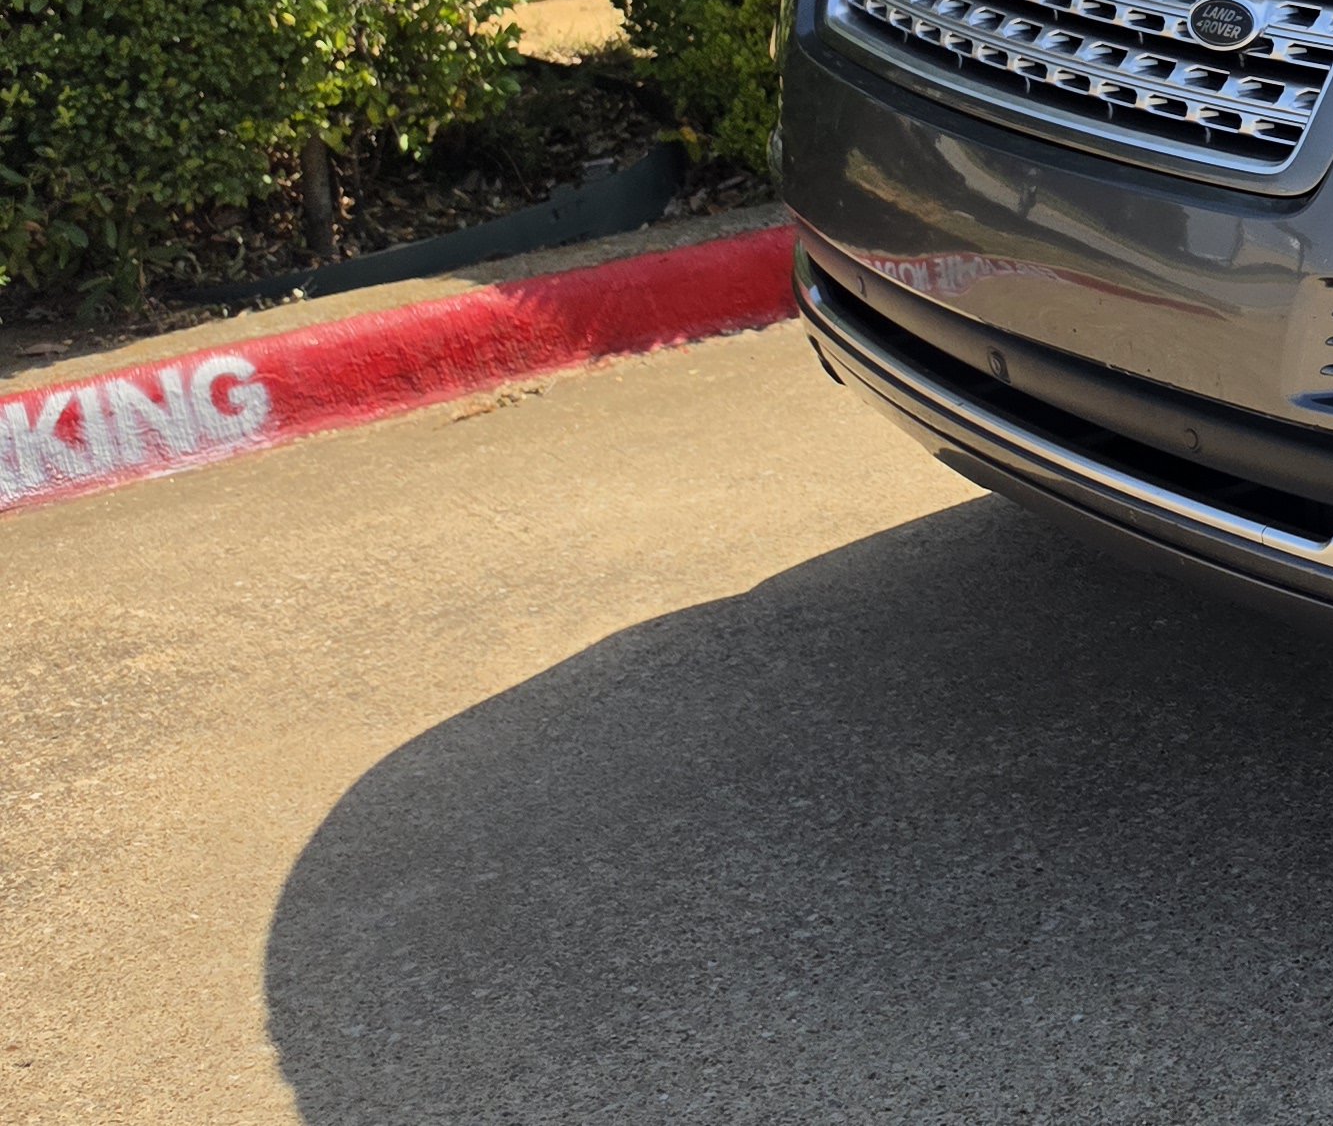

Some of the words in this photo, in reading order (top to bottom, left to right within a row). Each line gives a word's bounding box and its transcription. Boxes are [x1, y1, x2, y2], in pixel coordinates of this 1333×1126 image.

[1202, 4, 1236, 22] LAND
[1201, 19, 1241, 39] ROVER
[0, 356, 270, 506] KING
